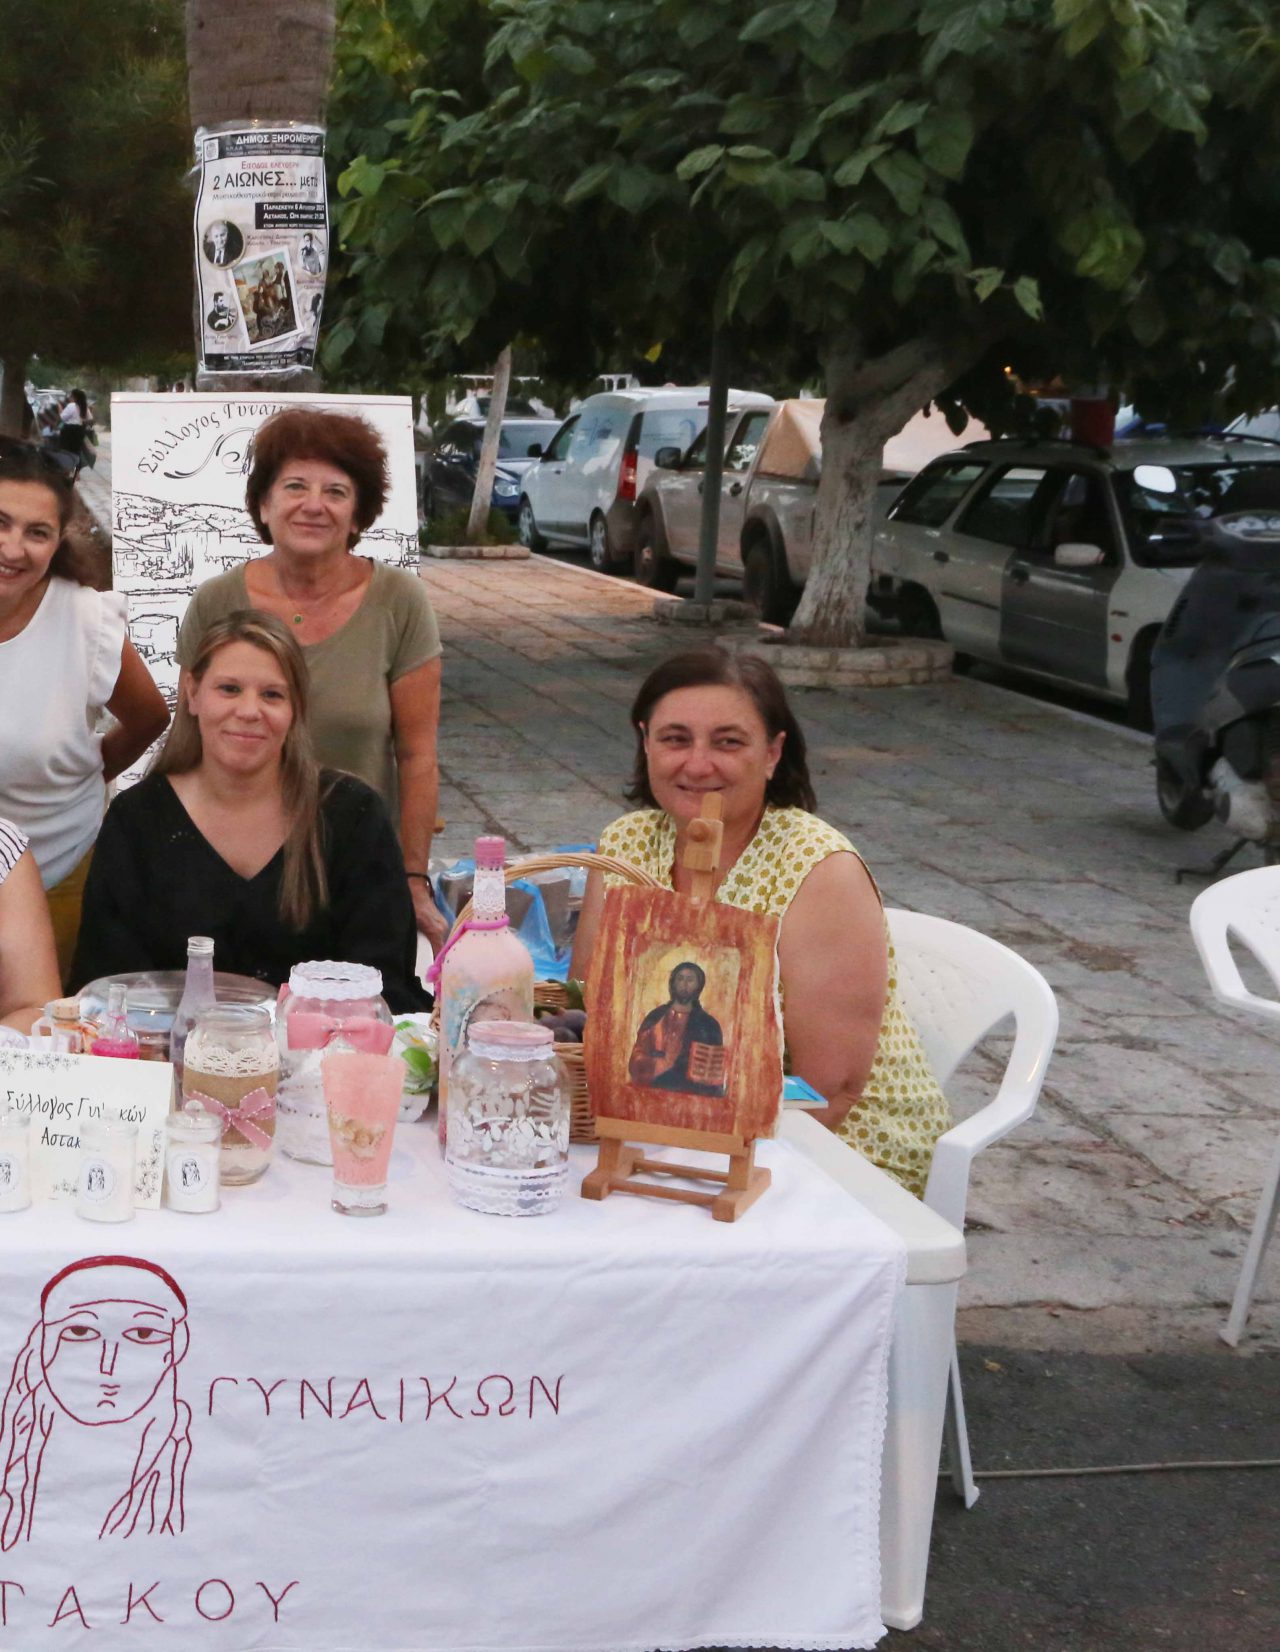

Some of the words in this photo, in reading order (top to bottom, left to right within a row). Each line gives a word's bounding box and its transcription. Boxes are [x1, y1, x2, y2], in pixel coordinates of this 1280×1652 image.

[236, 134, 269, 145] ΔΗΜΟΣ
[213, 175, 220, 190] 2
[137, 411, 221, 474] Σύλλογος
[223, 402, 283, 419] Γυναι
[7, 1090, 74, 1121] Σύλλογος
[77, 1097, 147, 1123] Γυνκών
[208, 1373, 566, 1423] ΓΥΝΑΙΚΩΝ
